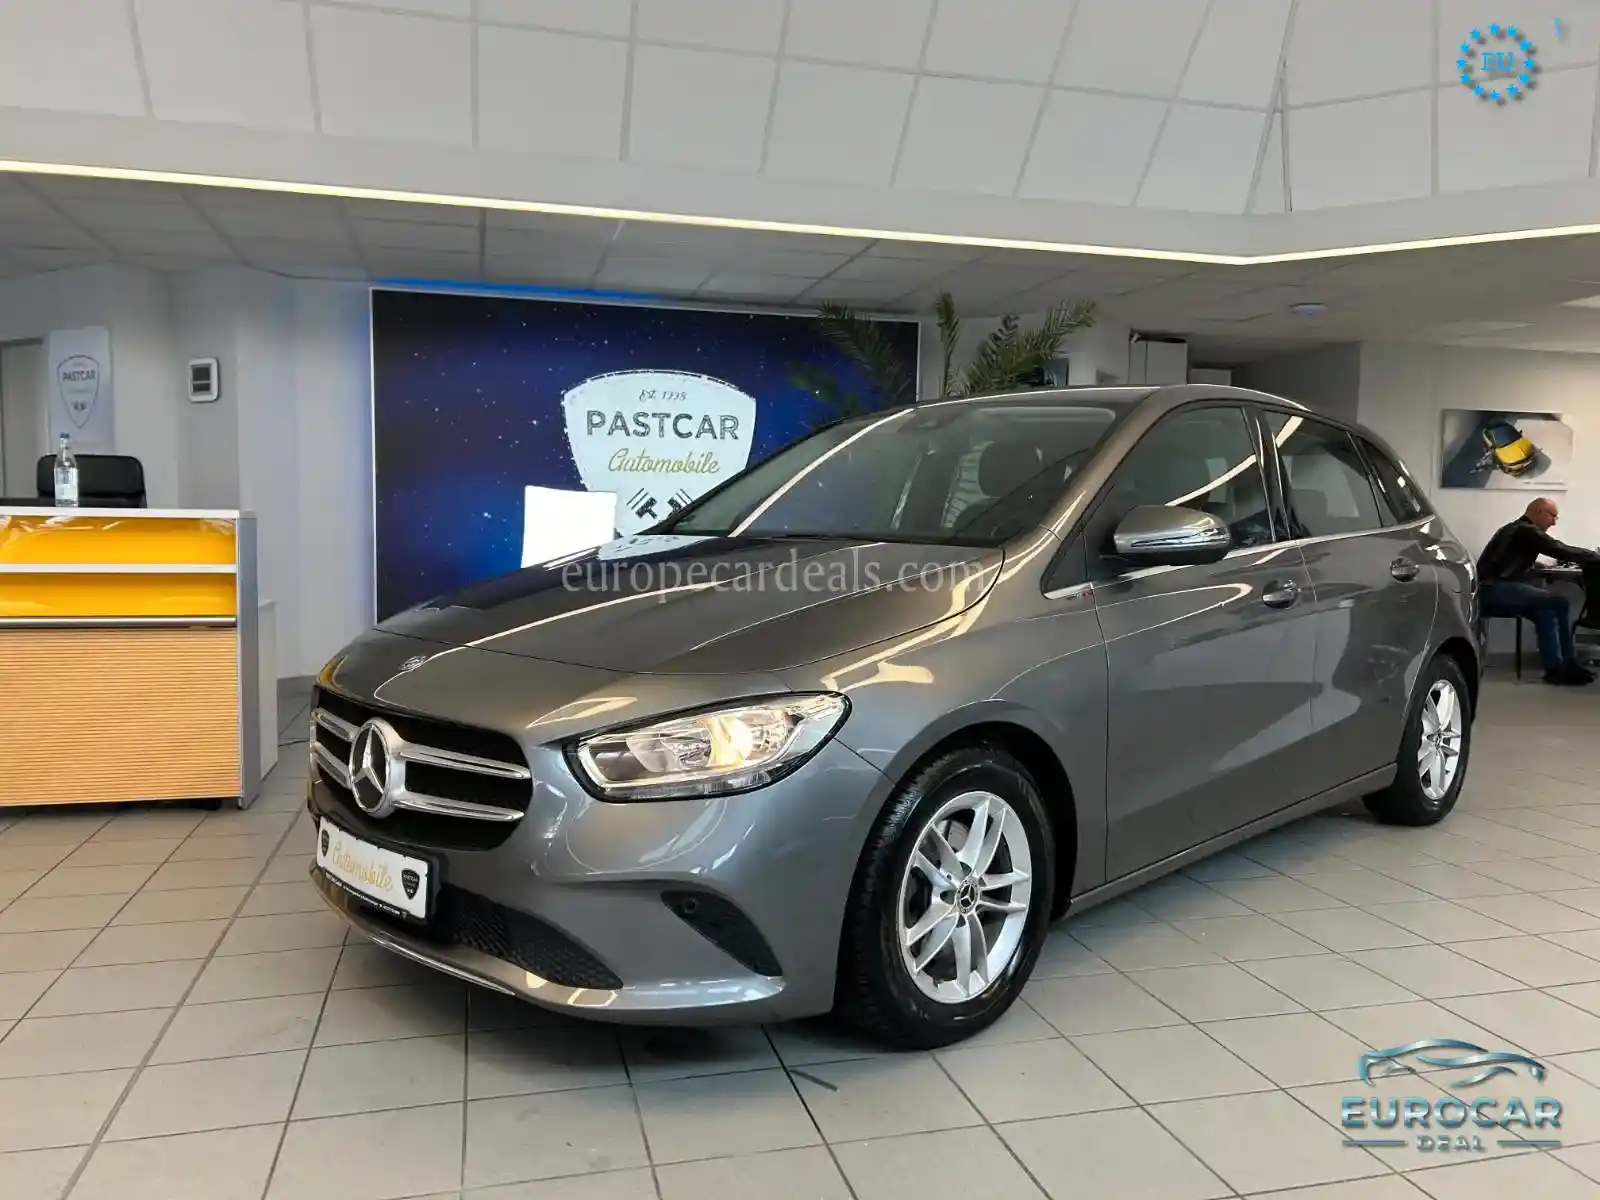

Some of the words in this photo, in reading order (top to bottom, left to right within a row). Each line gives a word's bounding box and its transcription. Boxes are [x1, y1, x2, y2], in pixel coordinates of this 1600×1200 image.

[62, 370, 96, 382] PASTCAR
[586, 410, 739, 439] PASTCAR
[608, 448, 719, 474] Automobile
[332, 841, 393, 892] Automobile
